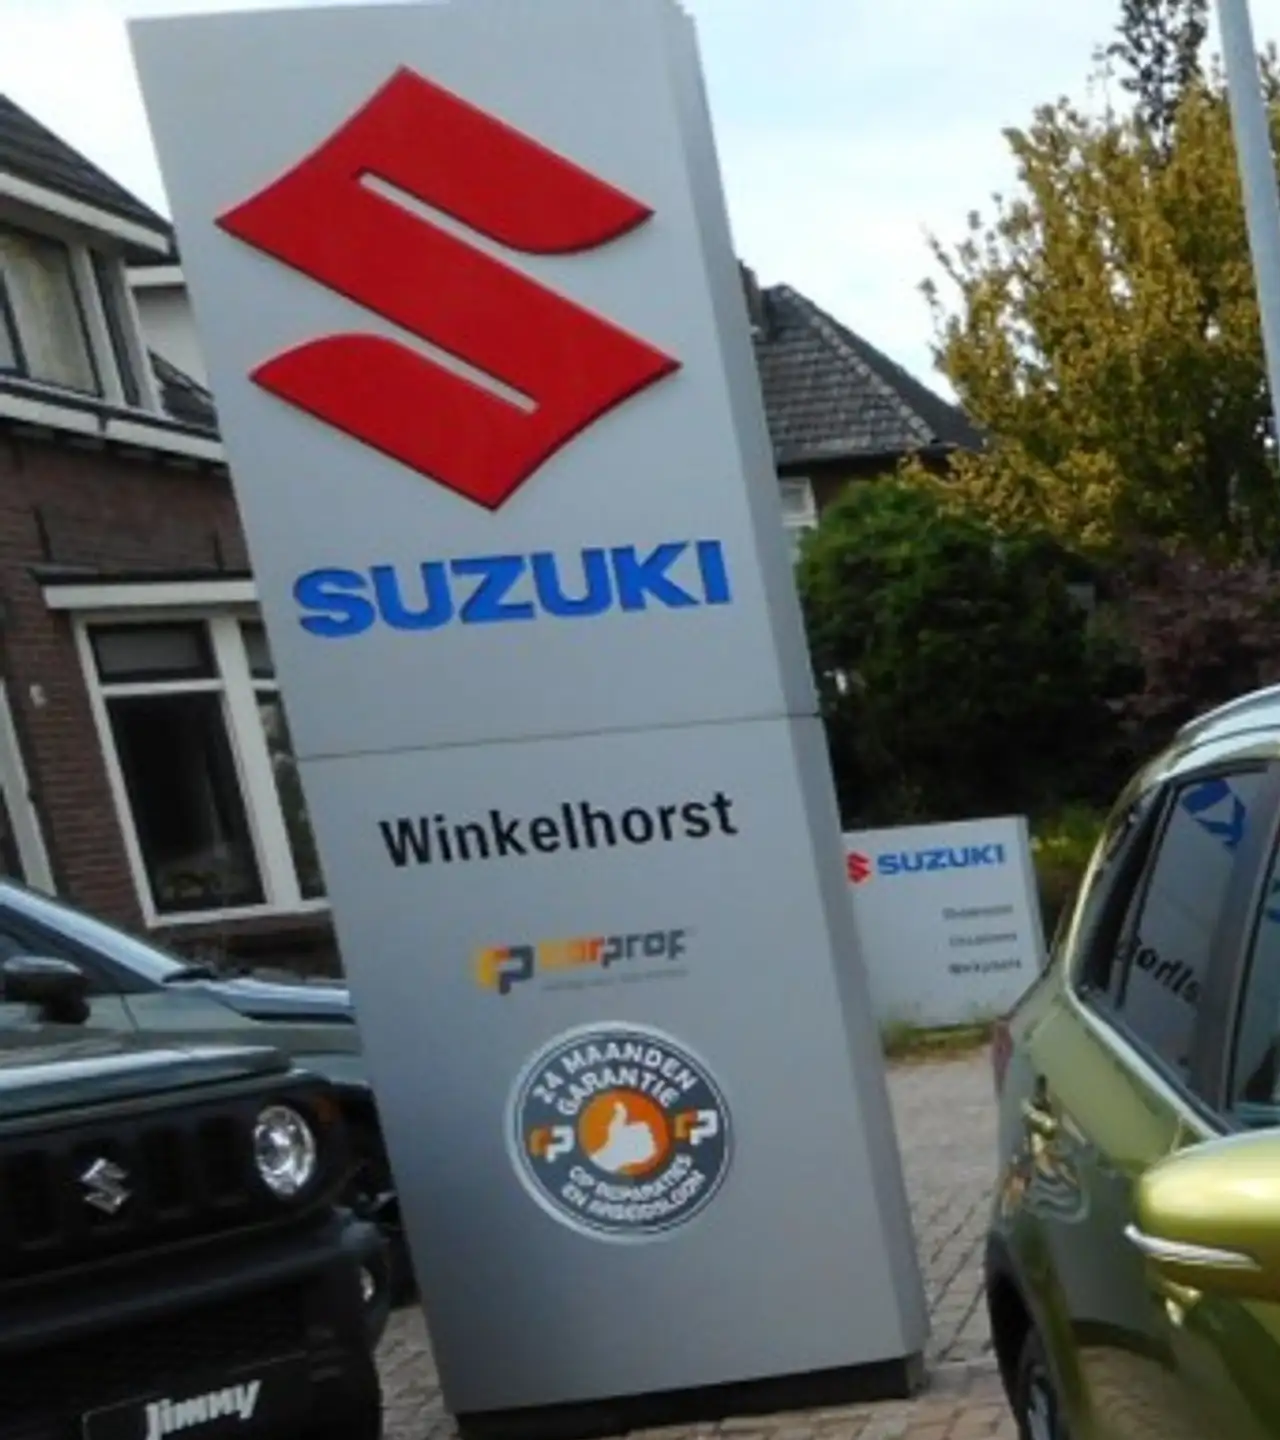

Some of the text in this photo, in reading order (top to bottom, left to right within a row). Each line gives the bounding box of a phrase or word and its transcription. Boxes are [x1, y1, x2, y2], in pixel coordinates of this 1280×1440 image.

[292, 539, 734, 638] SUZUKI
[379, 791, 738, 868] Winkelhorst
[876, 843, 1004, 876] SUZUKI
[532, 1041, 698, 1104] 24 MAANDEN
[556, 1066, 681, 1117] GARANTIE
